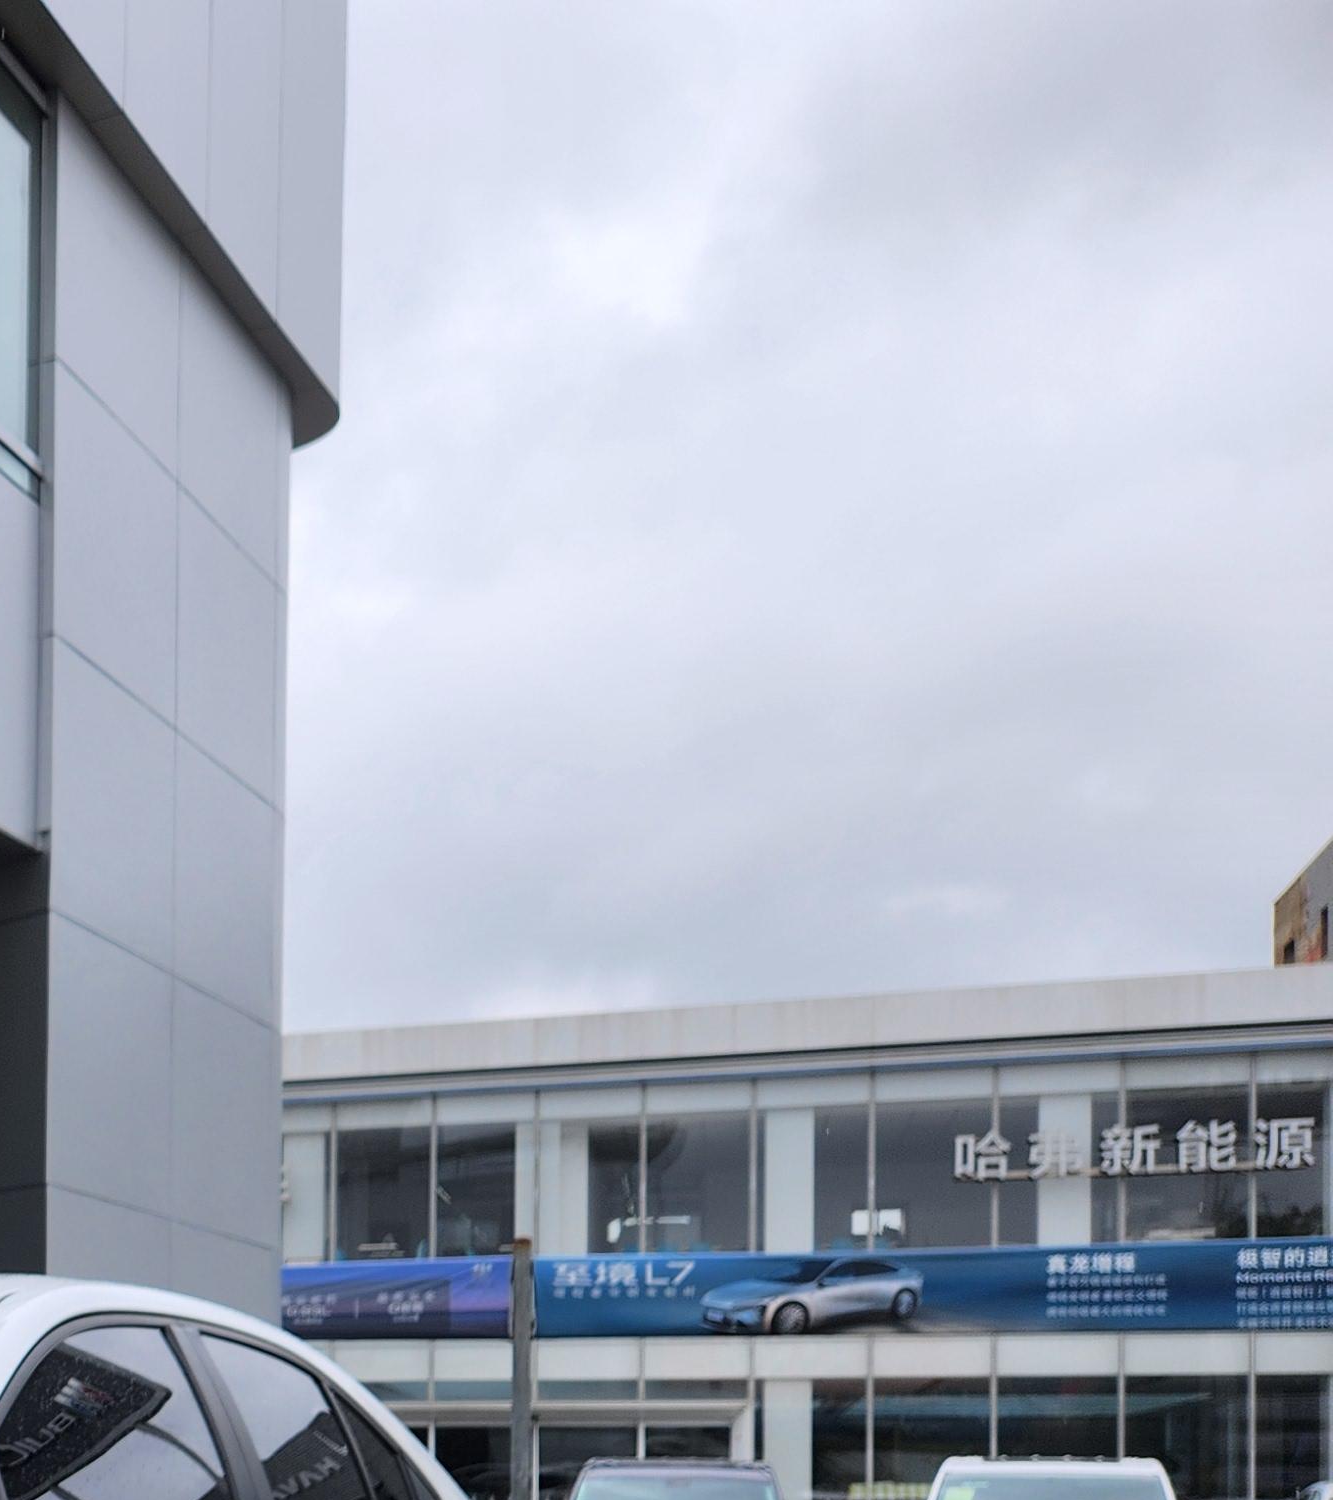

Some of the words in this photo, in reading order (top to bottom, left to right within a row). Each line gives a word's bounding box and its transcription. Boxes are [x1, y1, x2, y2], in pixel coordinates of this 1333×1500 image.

[953, 1117, 1316, 1181] 哈弗新能源
